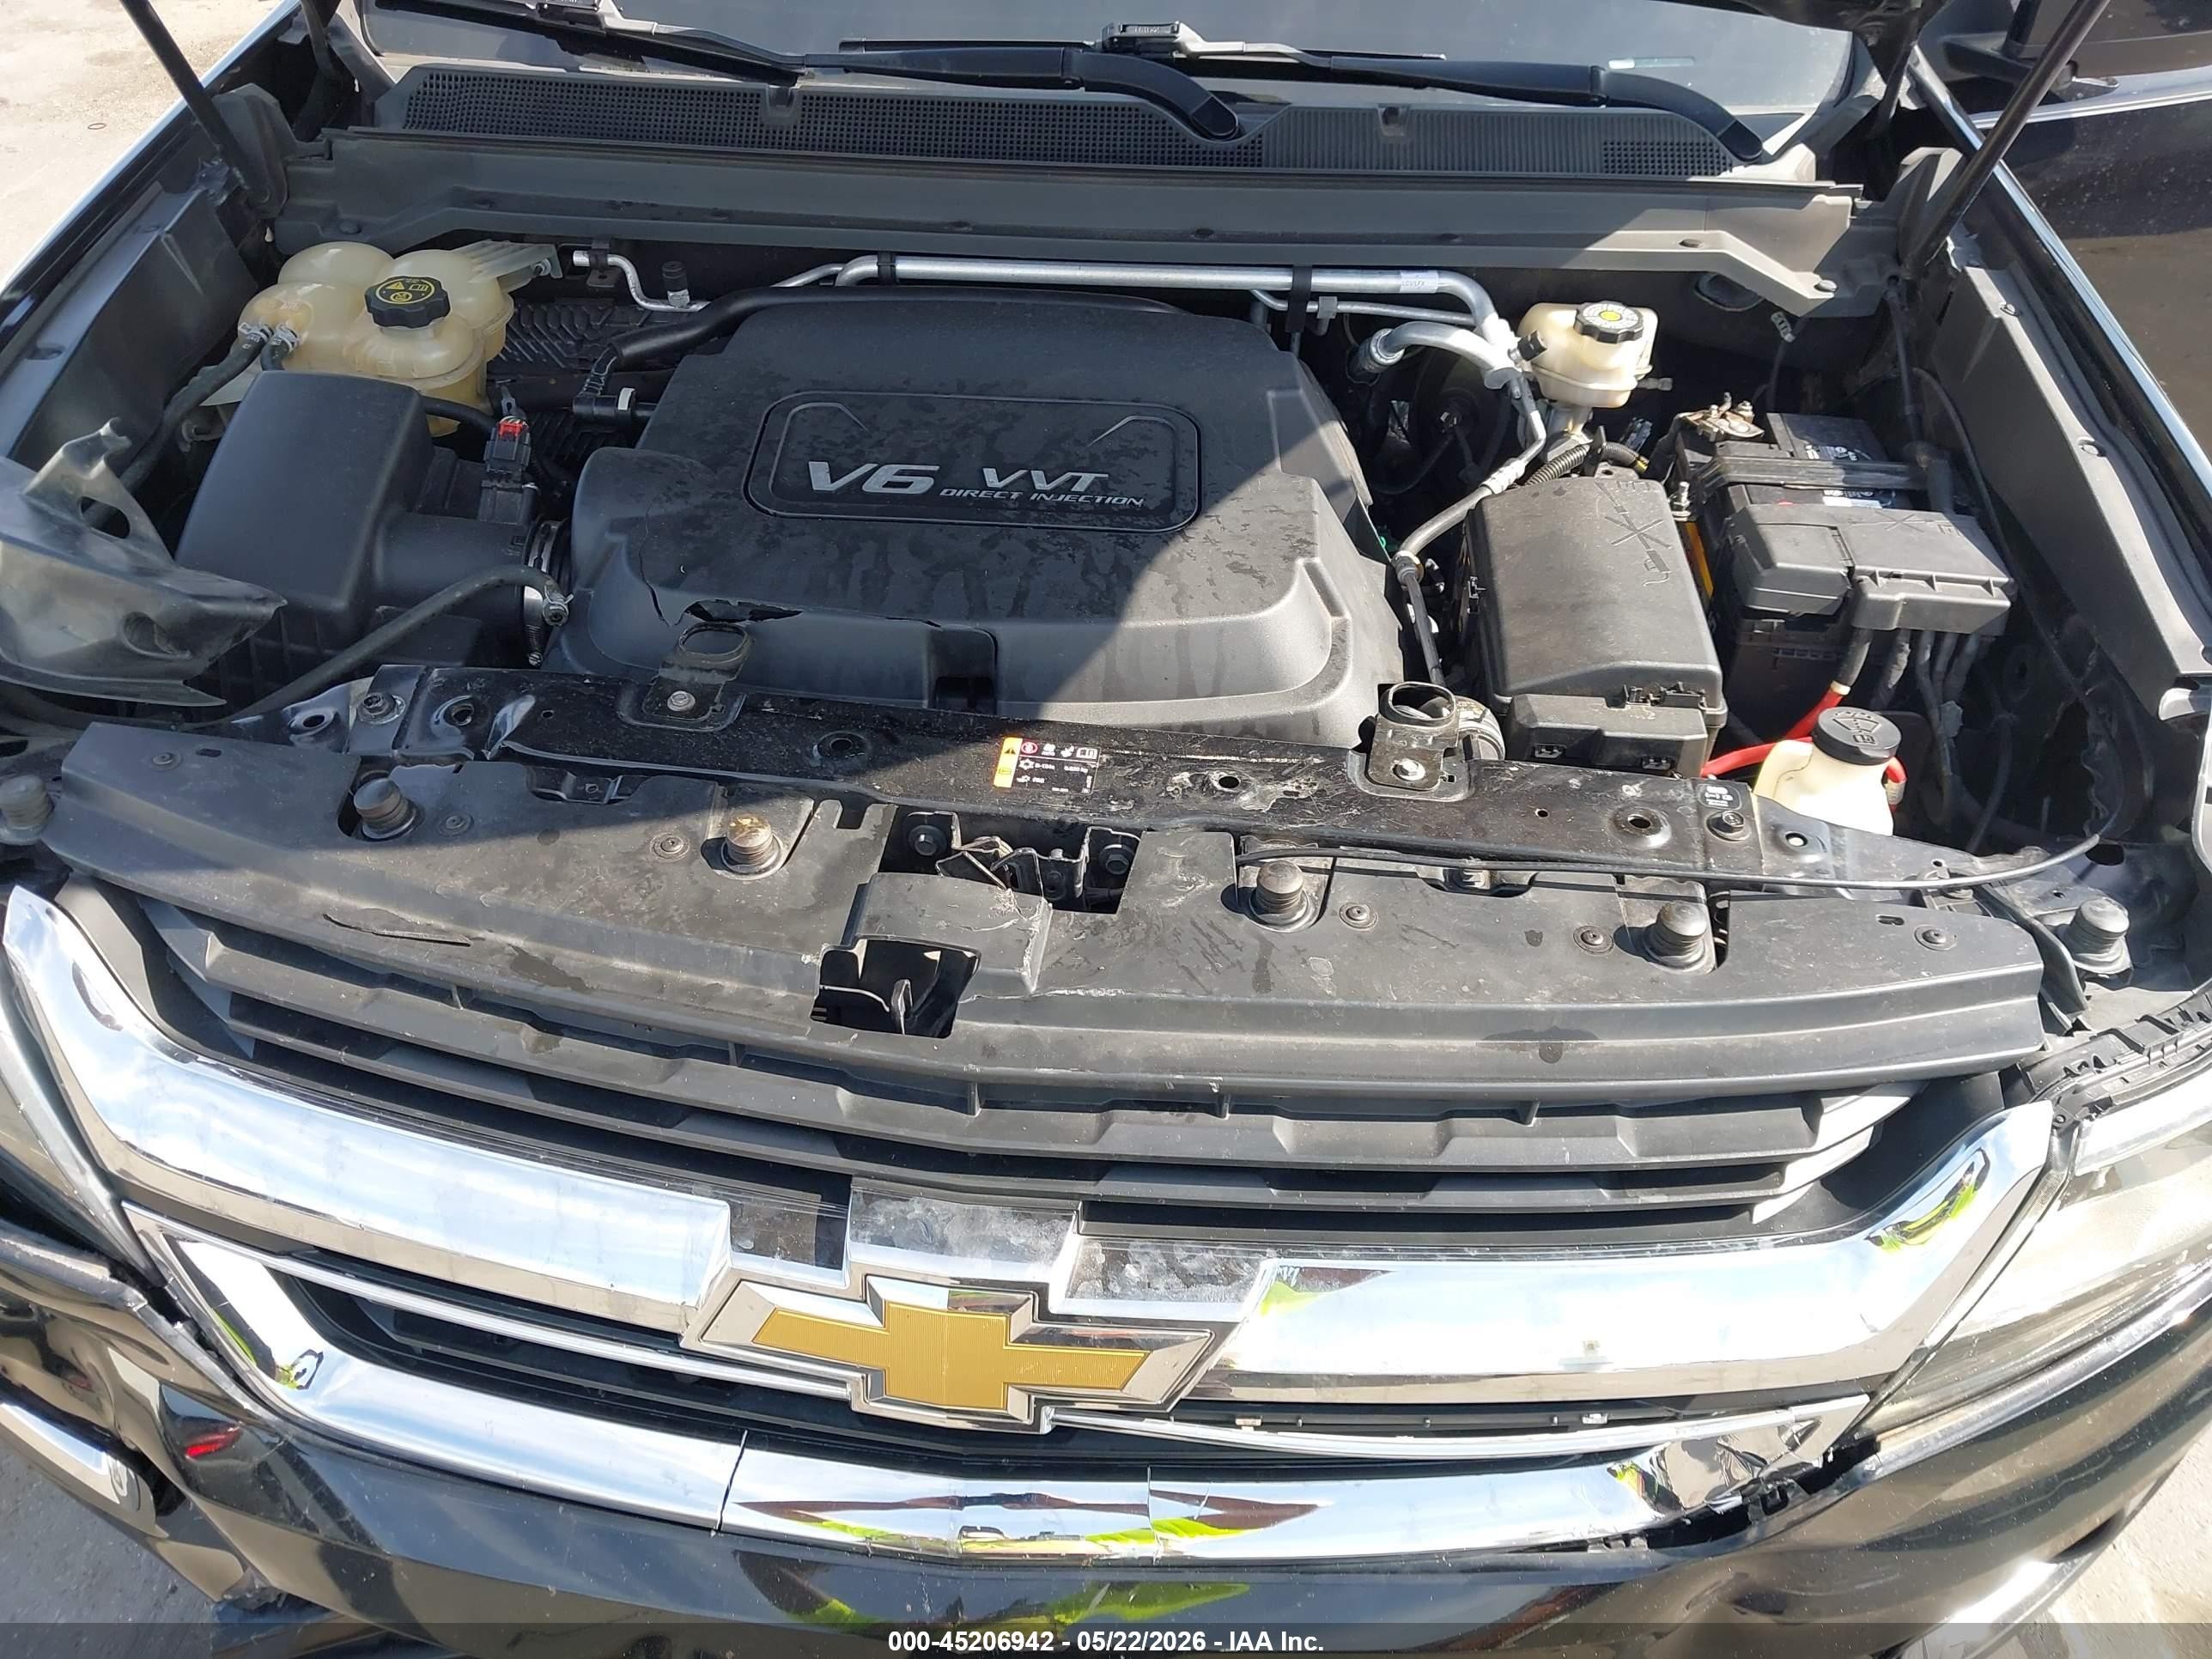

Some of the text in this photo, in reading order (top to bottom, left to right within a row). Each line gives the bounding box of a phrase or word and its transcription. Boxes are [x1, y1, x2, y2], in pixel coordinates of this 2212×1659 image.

[808, 461, 940, 495] V6
[982, 467, 1109, 493] VVT
[939, 489, 1144, 507] DIRECT INJECTION
